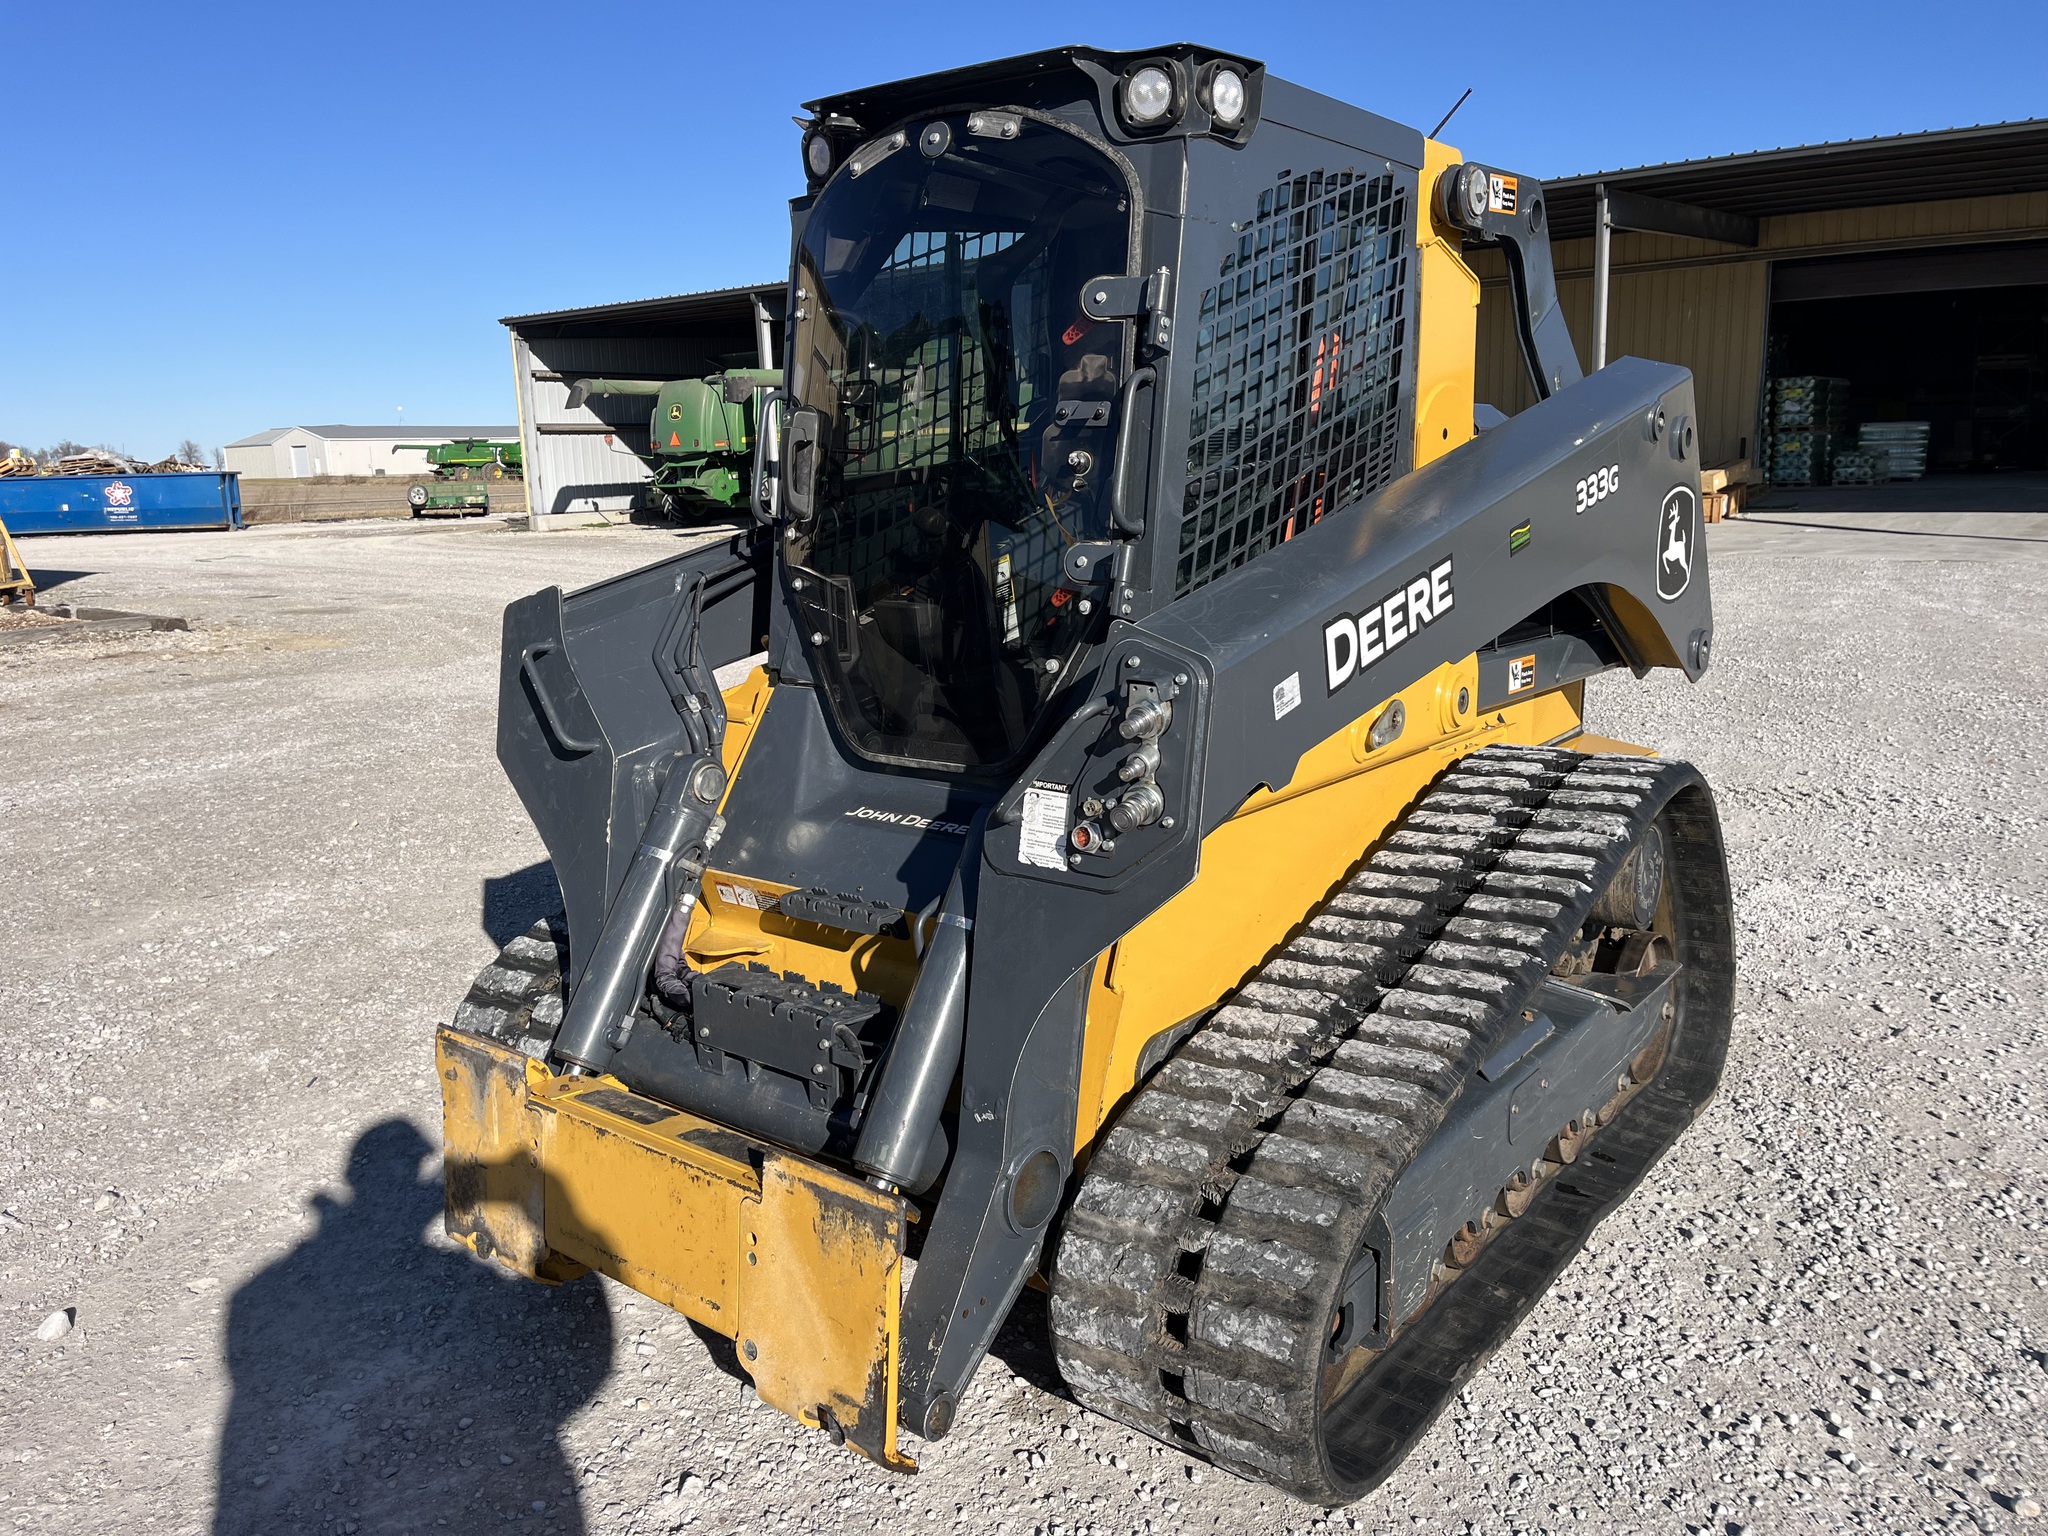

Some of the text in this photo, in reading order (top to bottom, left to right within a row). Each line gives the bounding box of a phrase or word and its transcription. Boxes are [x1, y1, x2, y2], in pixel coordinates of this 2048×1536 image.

[1576, 464, 1619, 513] 333G
[1325, 559, 1453, 690] DEERE
[845, 806, 970, 835] JOHN DEERE
